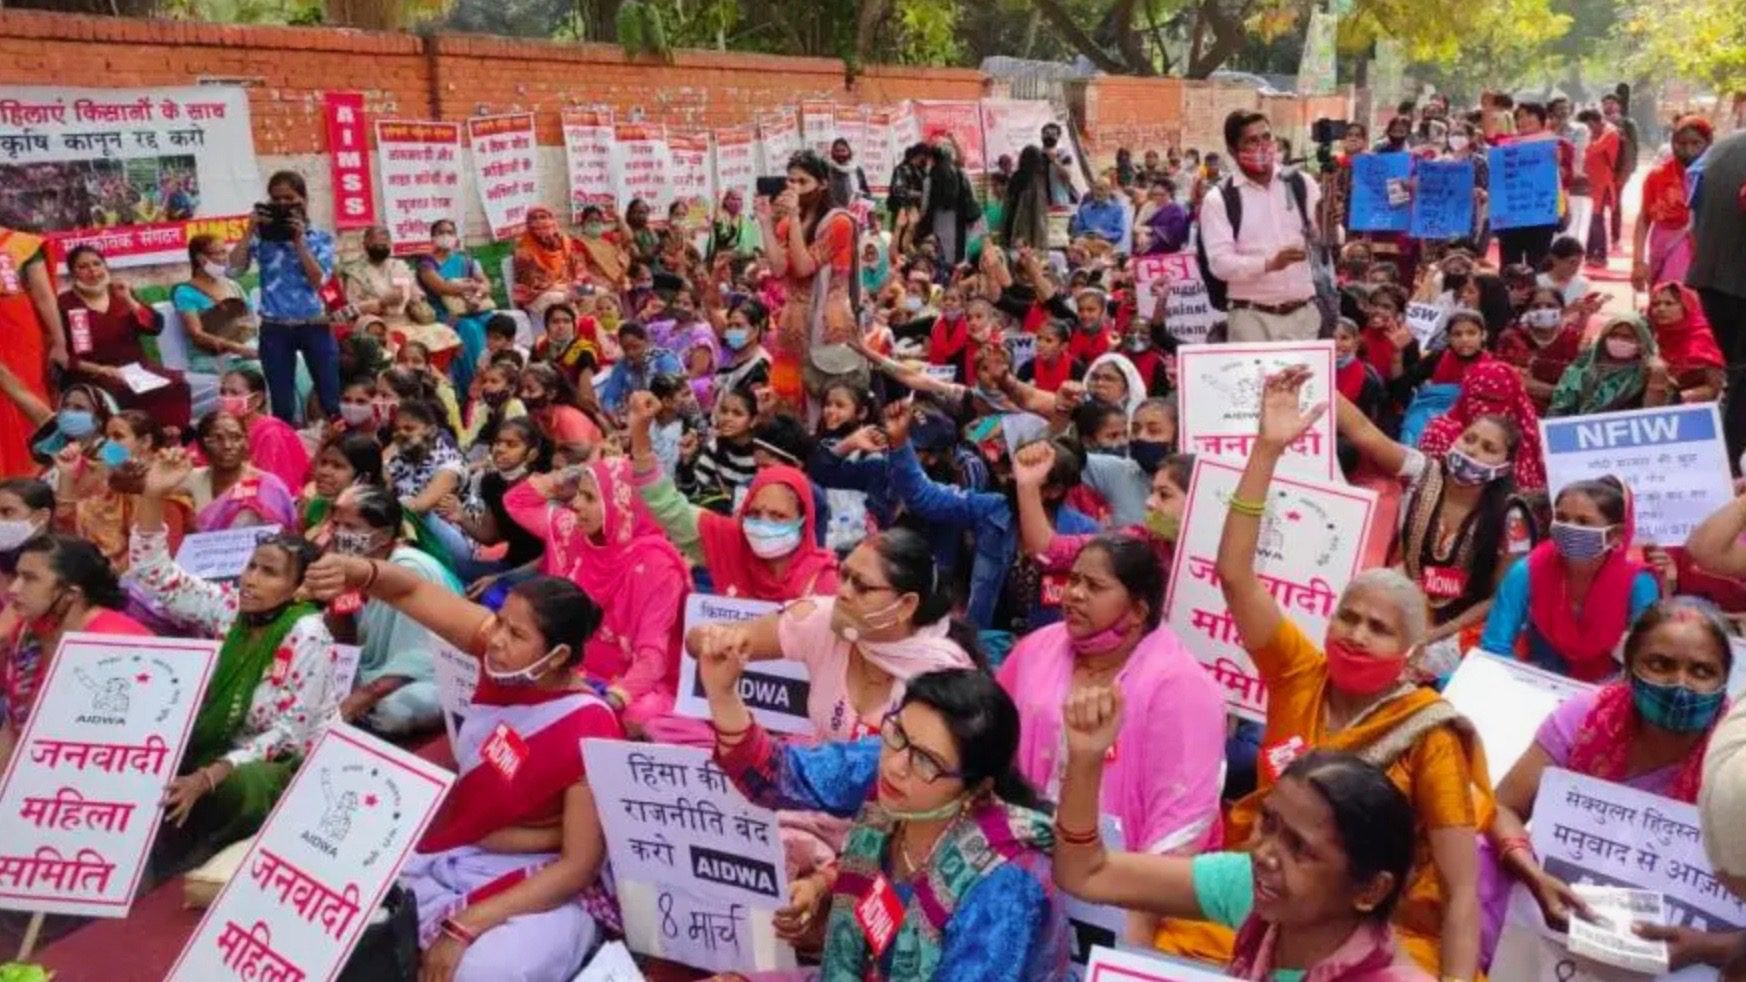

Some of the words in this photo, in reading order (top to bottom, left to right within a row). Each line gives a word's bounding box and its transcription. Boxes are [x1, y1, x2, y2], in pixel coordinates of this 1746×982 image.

[160, 98, 180, 120] के
[62, 131, 122, 156] कानून
[168, 124, 205, 146] करो
[336, 105, 366, 216] AIMSS
[1408, 306, 1439, 321] SW
[1577, 415, 1680, 450] NFIW
[740, 677, 791, 708] DWA
[31, 735, 170, 774] जनवादी
[627, 753, 688, 792] हिंसा
[696, 760, 727, 793] की
[20, 787, 136, 833] महिला
[619, 797, 726, 836] राजनीति
[733, 811, 769, 845] बंद
[1643, 807, 1700, 846] हिंदुस्त
[627, 834, 675, 866] करो
[1554, 823, 1631, 865] मनुवाद
[1636, 842, 1660, 872] से
[0, 846, 116, 893] समिति
[696, 856, 773, 893] AIDWA
[251, 848, 361, 941] जनवादी
[658, 892, 678, 939] 8
[688, 904, 746, 954] मार्च
